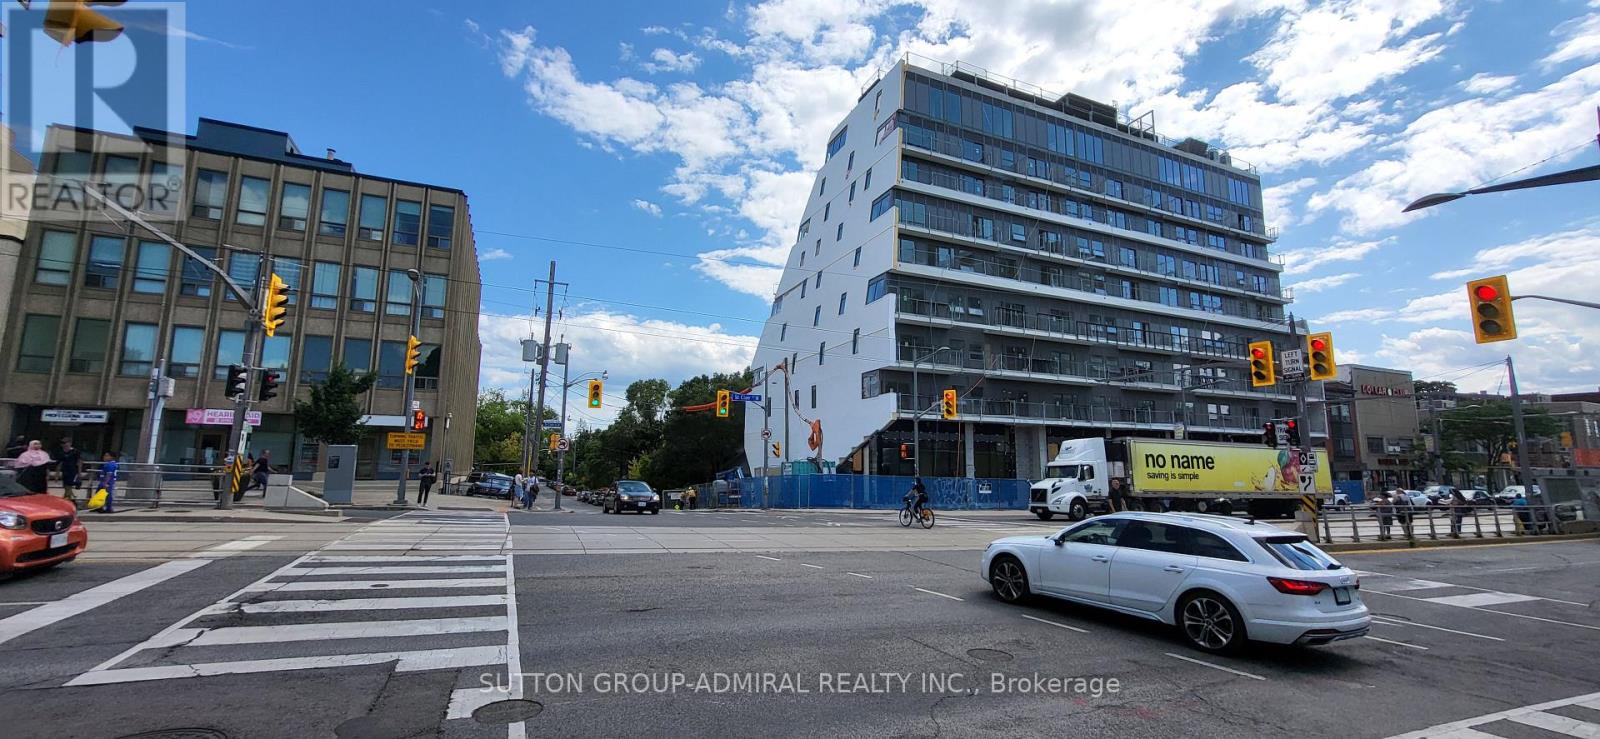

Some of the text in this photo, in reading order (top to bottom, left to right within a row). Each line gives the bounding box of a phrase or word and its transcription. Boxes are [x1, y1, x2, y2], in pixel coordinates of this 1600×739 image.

[1145, 453, 1215, 470] no name
[1146, 470, 1200, 482] saving is simple
